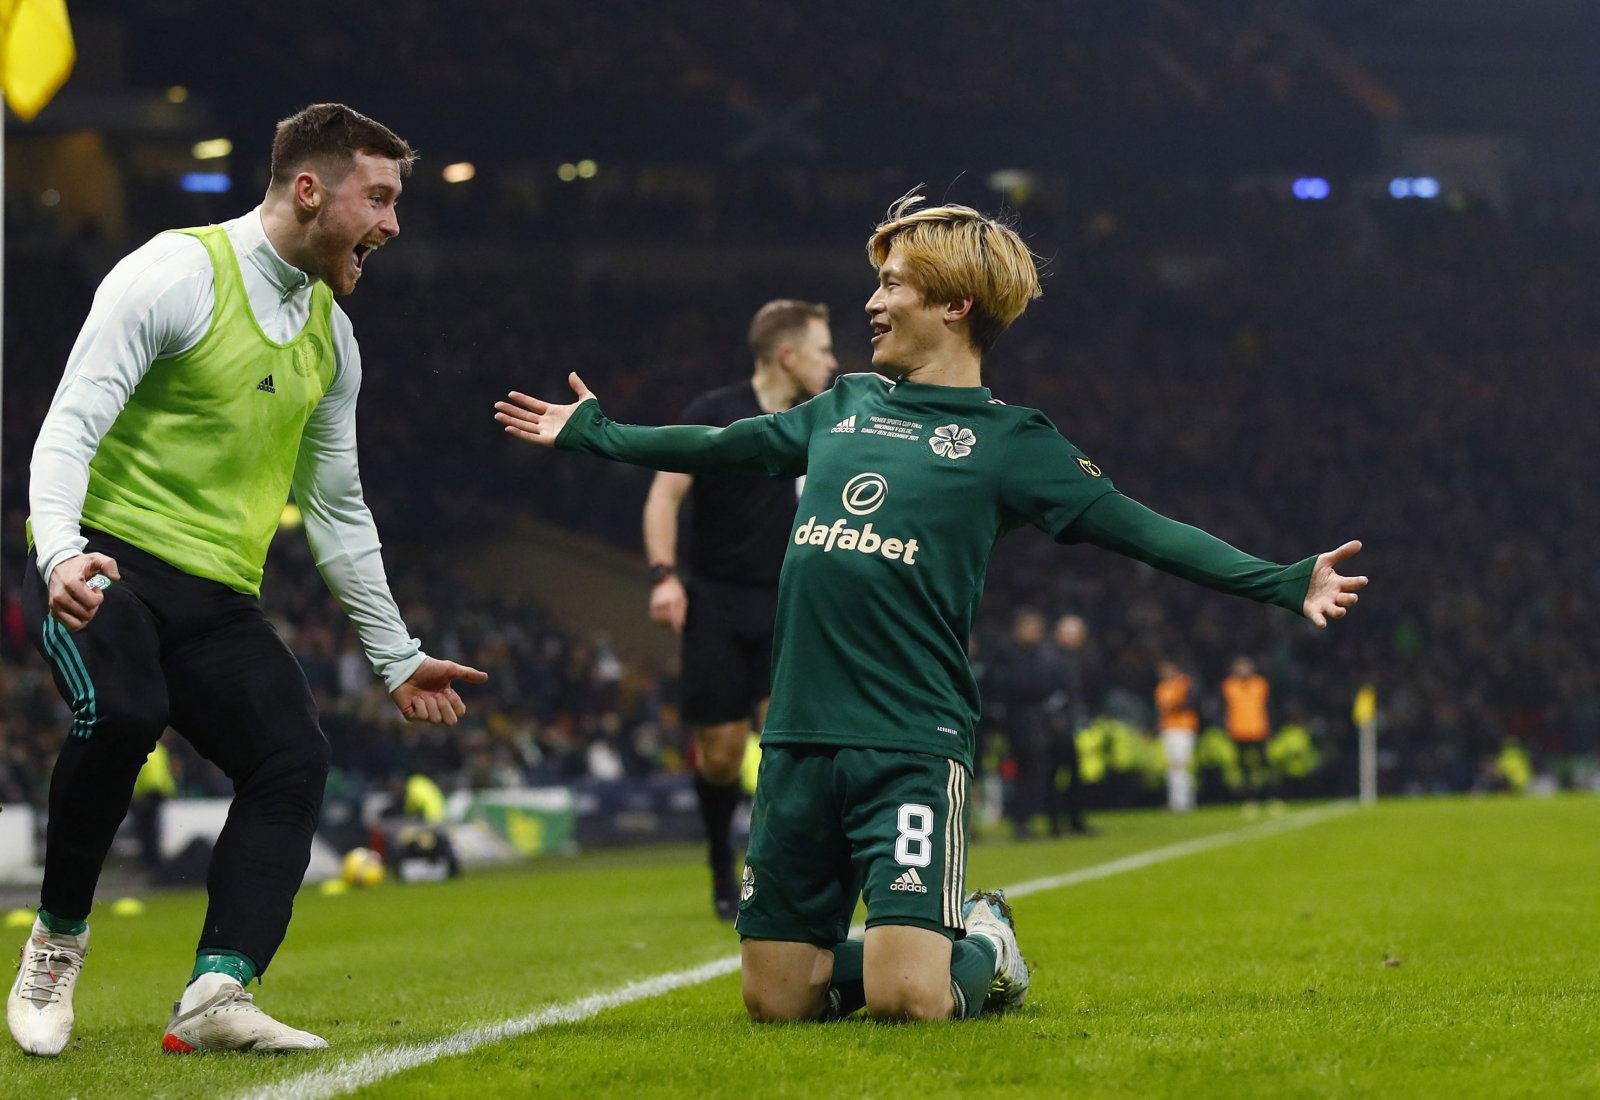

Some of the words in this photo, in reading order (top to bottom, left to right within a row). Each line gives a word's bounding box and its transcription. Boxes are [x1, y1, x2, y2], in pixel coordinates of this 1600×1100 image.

[830, 426, 856, 434] adidas
[794, 516, 919, 565] dafabet
[894, 803, 934, 867] 8
[890, 882, 928, 893] adidas
